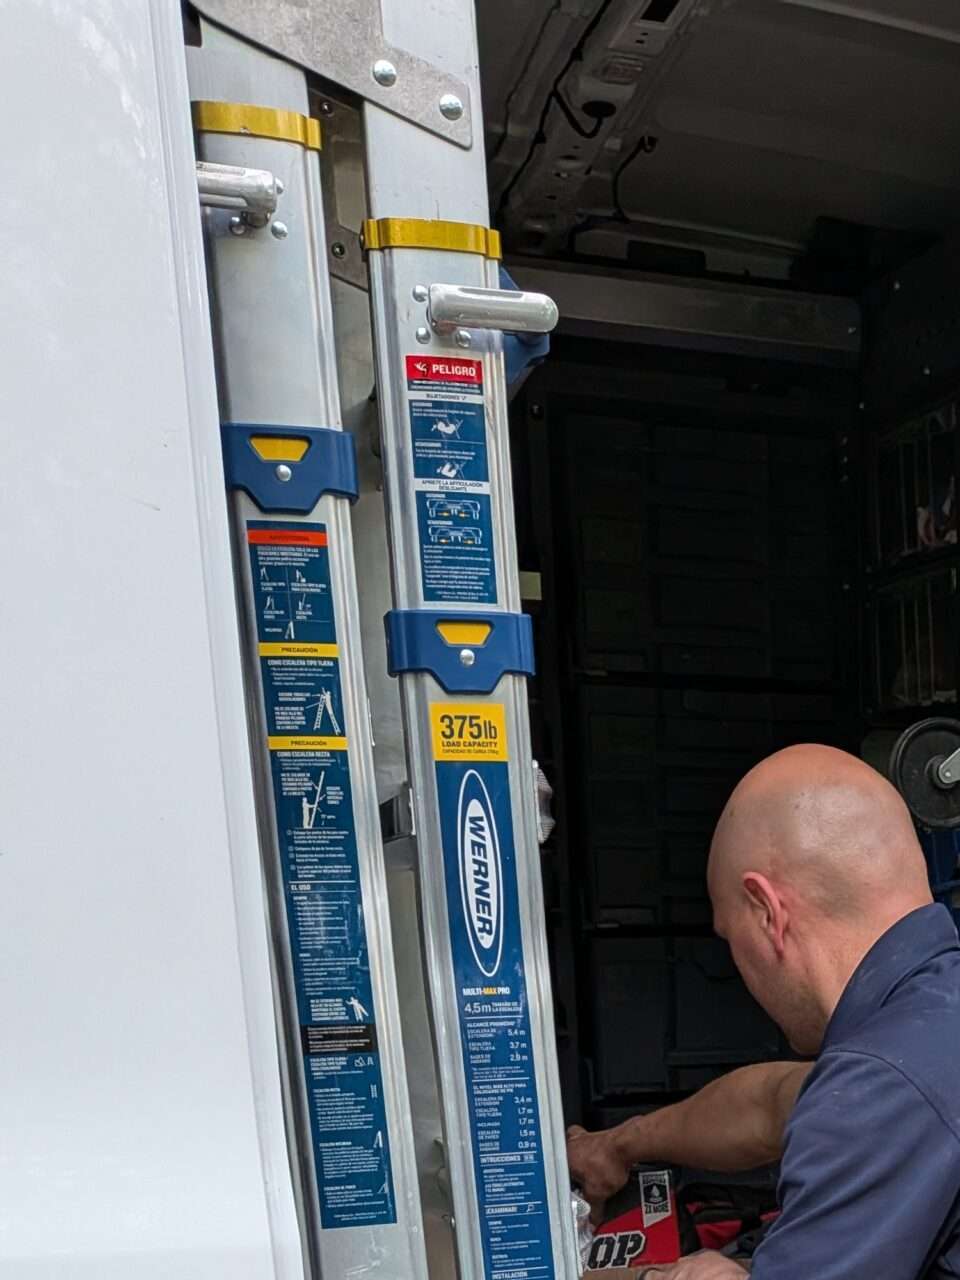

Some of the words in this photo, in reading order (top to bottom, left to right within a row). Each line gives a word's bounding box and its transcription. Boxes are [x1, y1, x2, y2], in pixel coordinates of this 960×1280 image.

[432, 364, 476, 377] PELIGRO
[468, 815, 493, 937] WERNER
[497, 986, 511, 995] PRO
